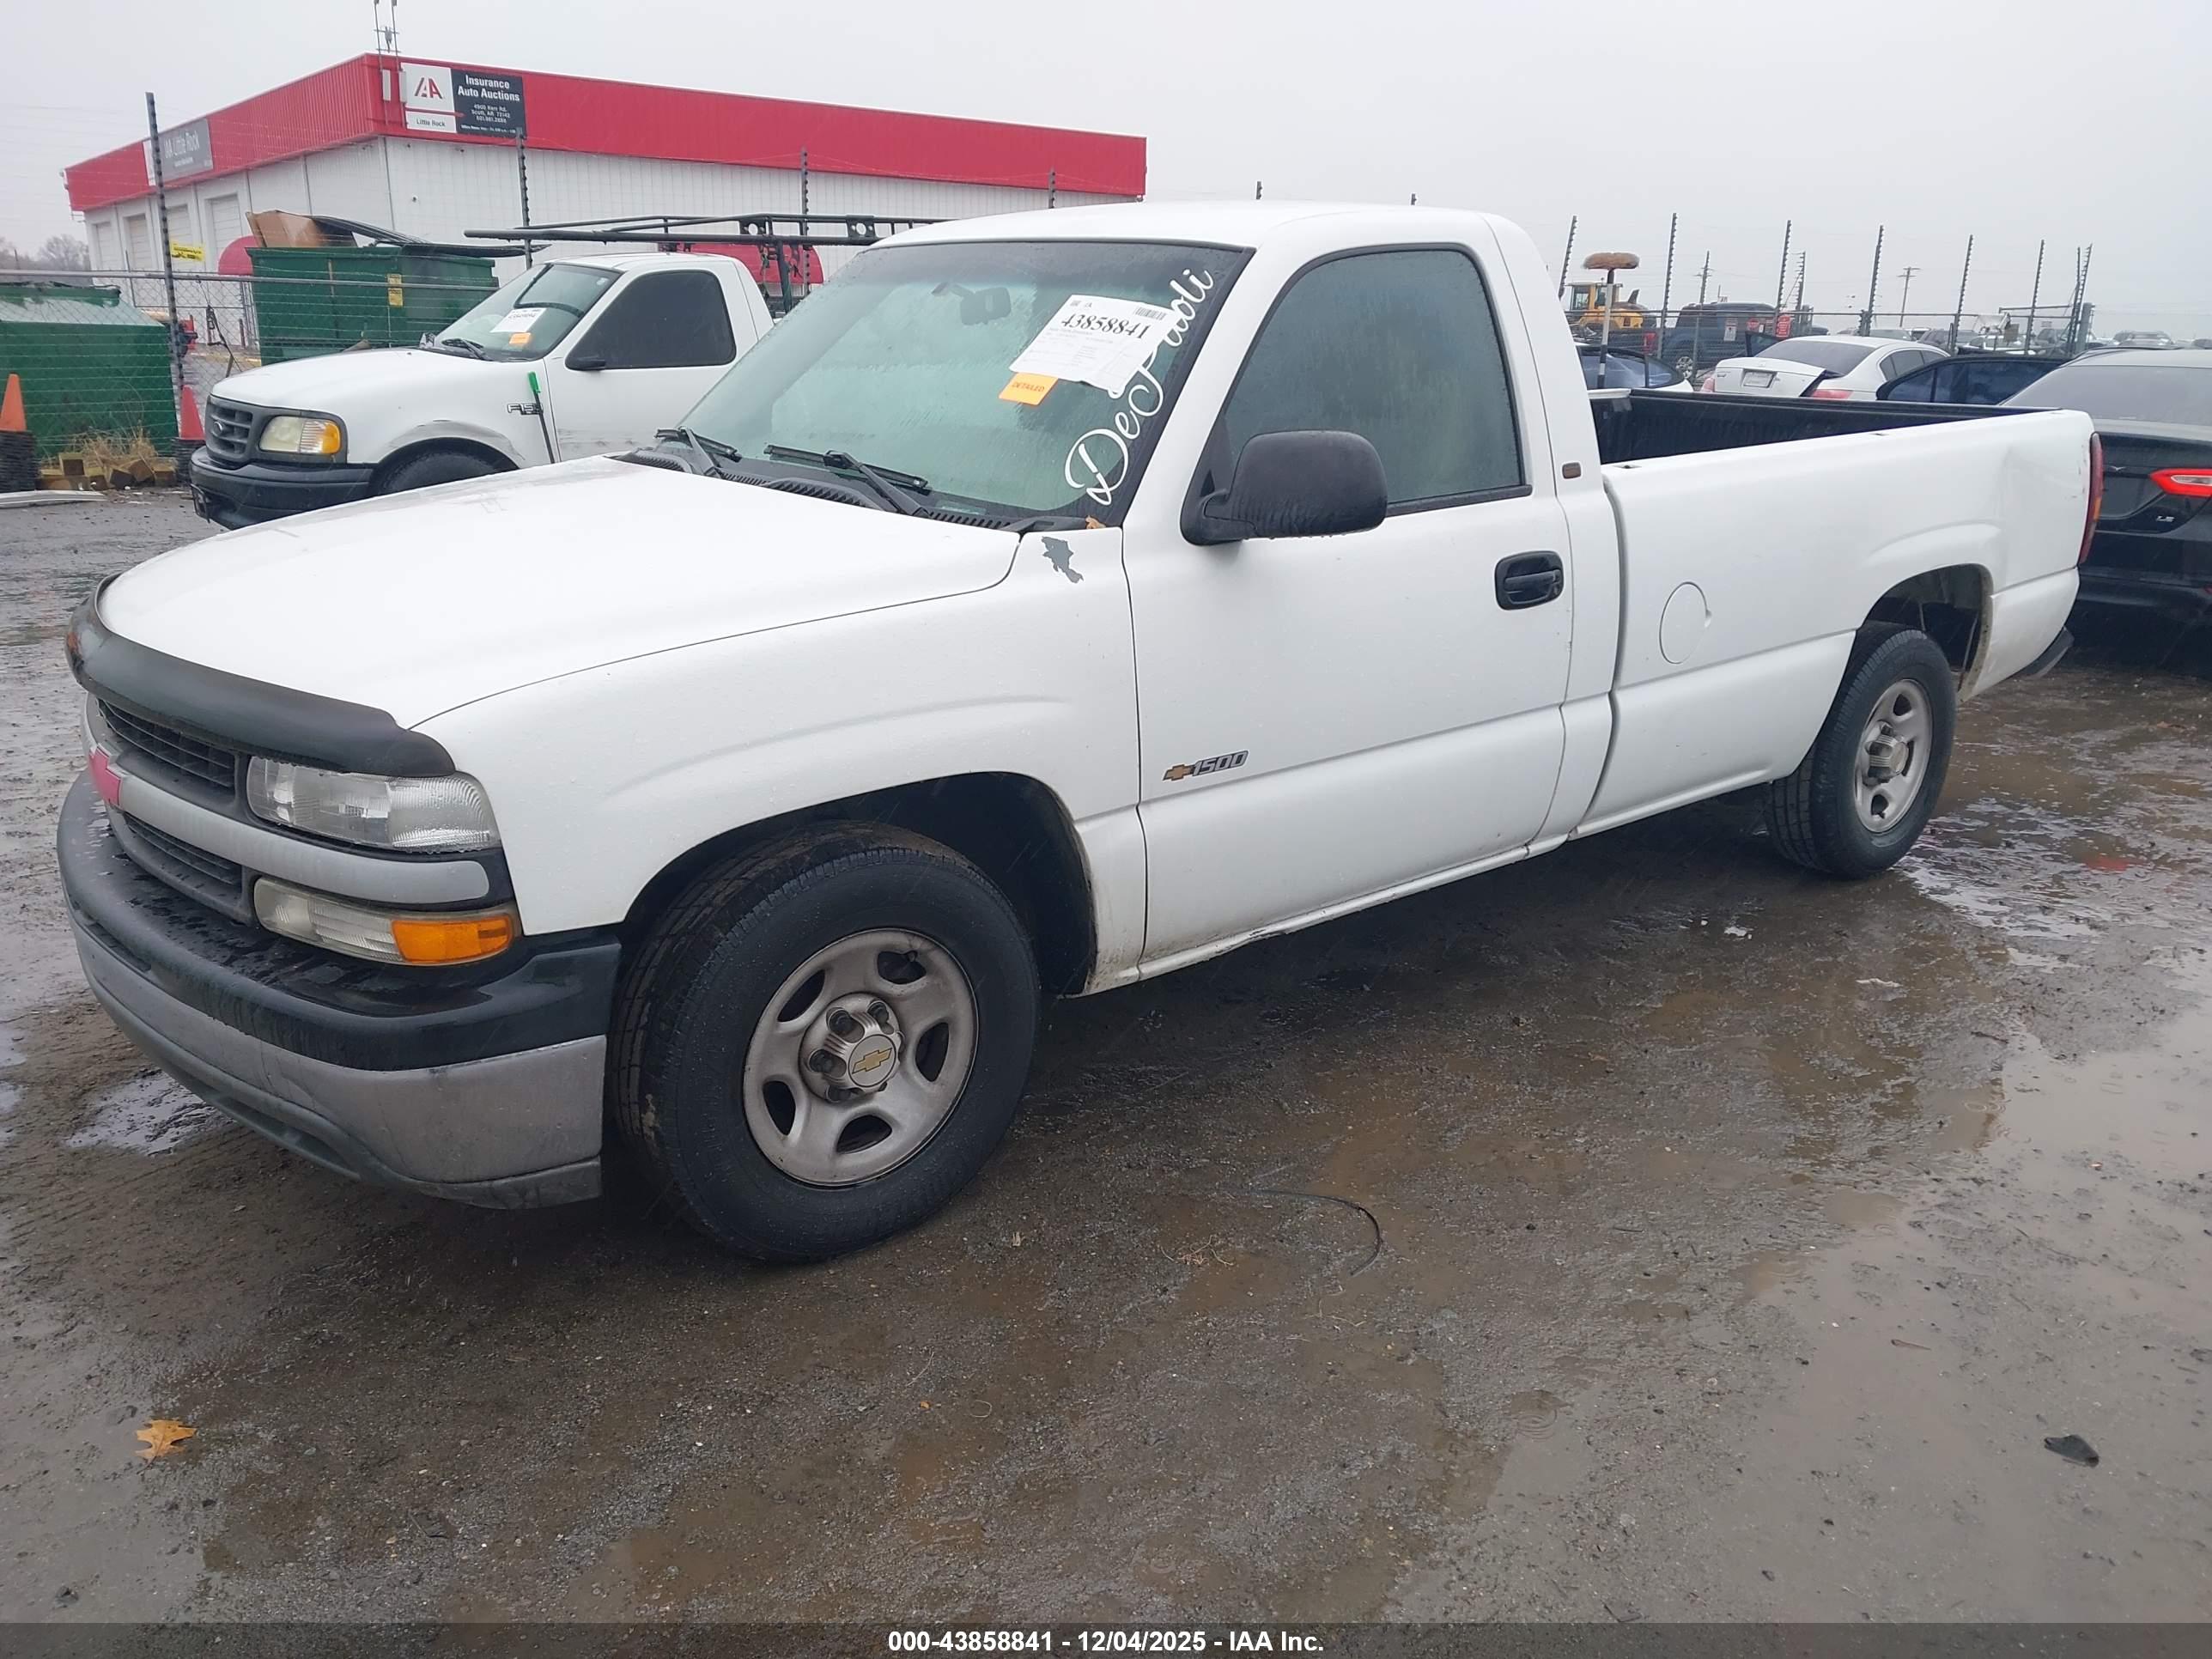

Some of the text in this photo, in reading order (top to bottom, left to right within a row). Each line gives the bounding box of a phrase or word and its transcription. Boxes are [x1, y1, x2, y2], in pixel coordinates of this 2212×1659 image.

[465, 75, 510, 89] Insurance
[458, 86, 520, 101] Auto Auctions
[1061, 313, 1152, 339] 43858841
[1011, 381, 1046, 392] DETAILED
[1192, 750, 1249, 776] 1500
